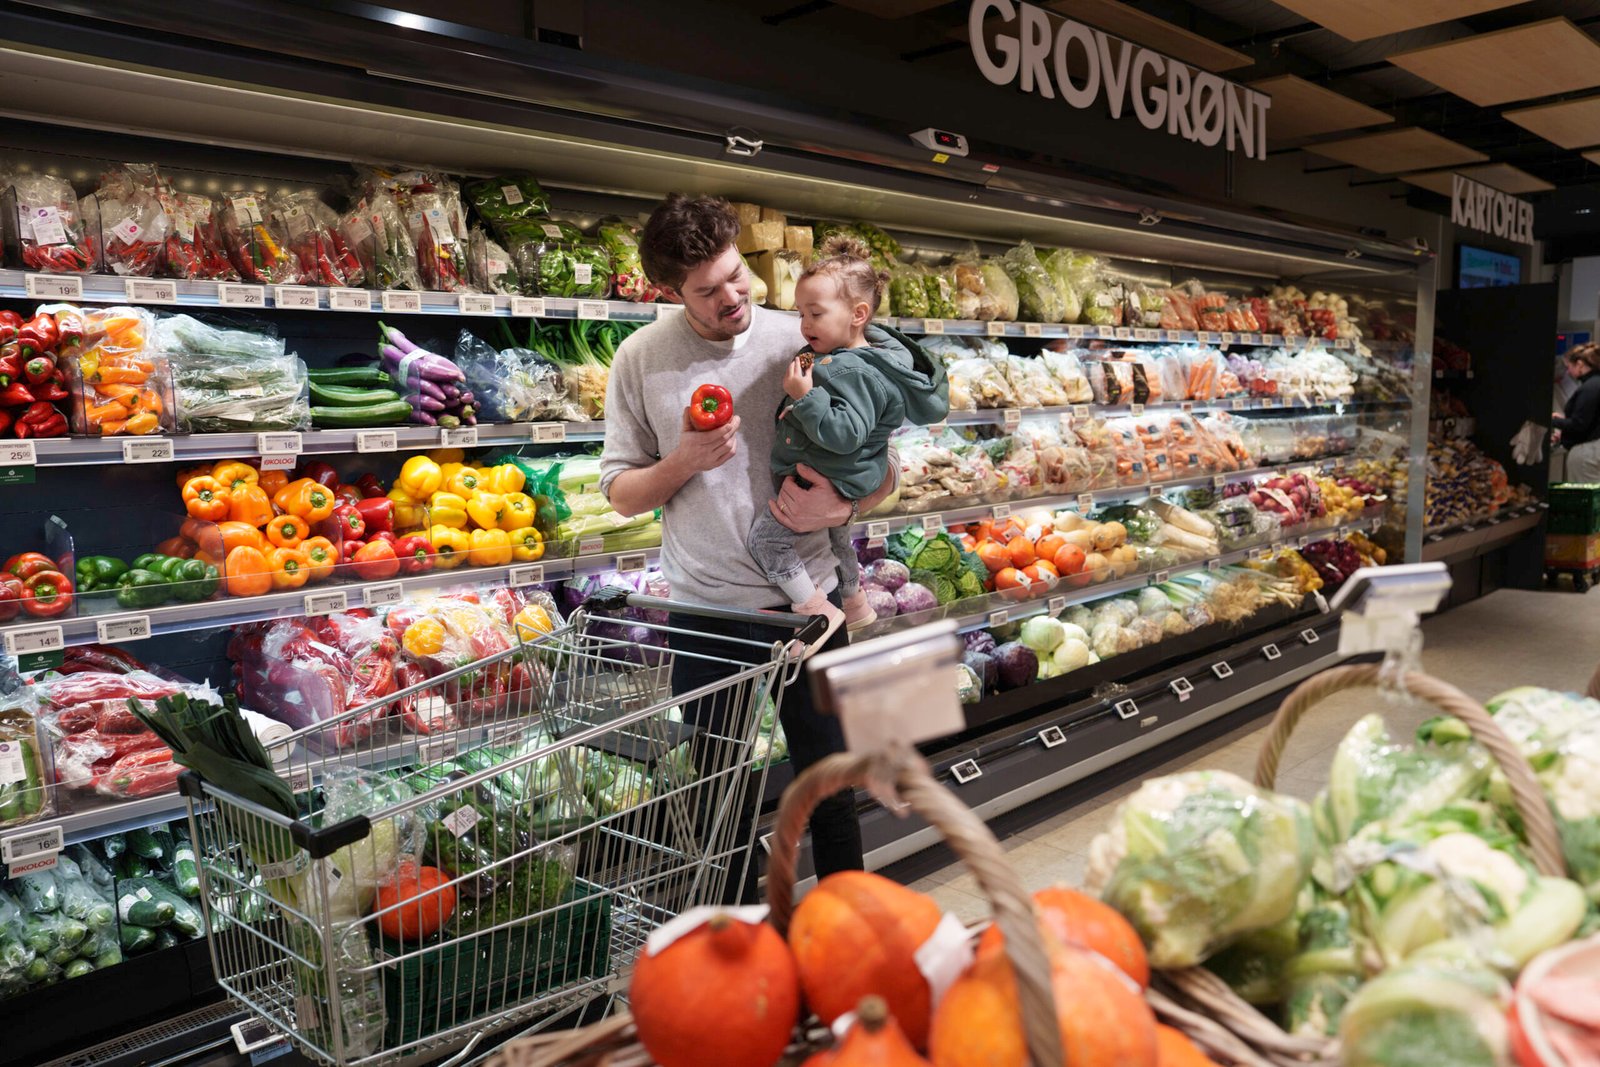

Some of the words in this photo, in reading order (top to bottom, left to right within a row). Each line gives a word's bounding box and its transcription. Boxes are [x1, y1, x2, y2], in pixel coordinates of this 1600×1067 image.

[968, 0, 1272, 161] GROVGRØNT
[1451, 173, 1534, 246] KARTOFLER
[12, 858, 56, 874] ØKOLOGI
